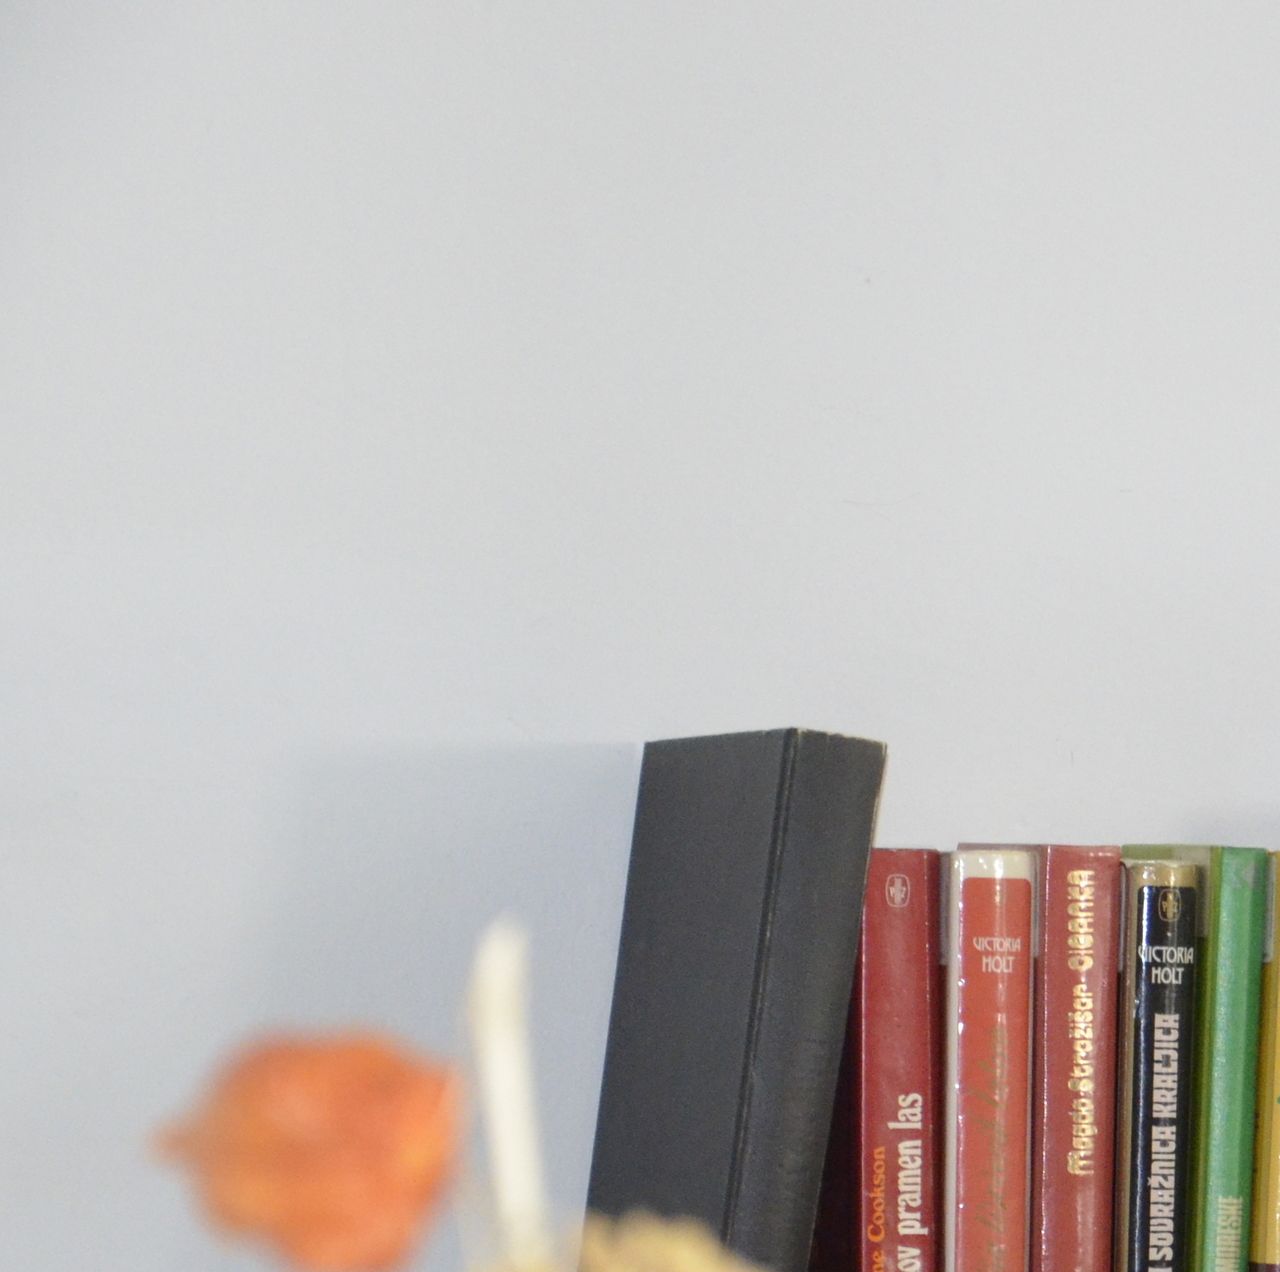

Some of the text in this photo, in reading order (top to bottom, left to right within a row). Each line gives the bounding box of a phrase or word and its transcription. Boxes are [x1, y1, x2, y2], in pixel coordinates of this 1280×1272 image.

[973, 937, 1021, 954] VICTORIA
[1138, 944, 1194, 965] VICTORIA
[982, 956, 1014, 974] HOLT
[1151, 966, 1184, 985] HOLT
[1153, 1013, 1179, 1119] KRALJICA
[887, 1092, 923, 1130] las
[868, 1145, 886, 1244] Cookson
[896, 1139, 929, 1236] pramen
[1149, 1125, 1177, 1264] SOVRAŽNICA
